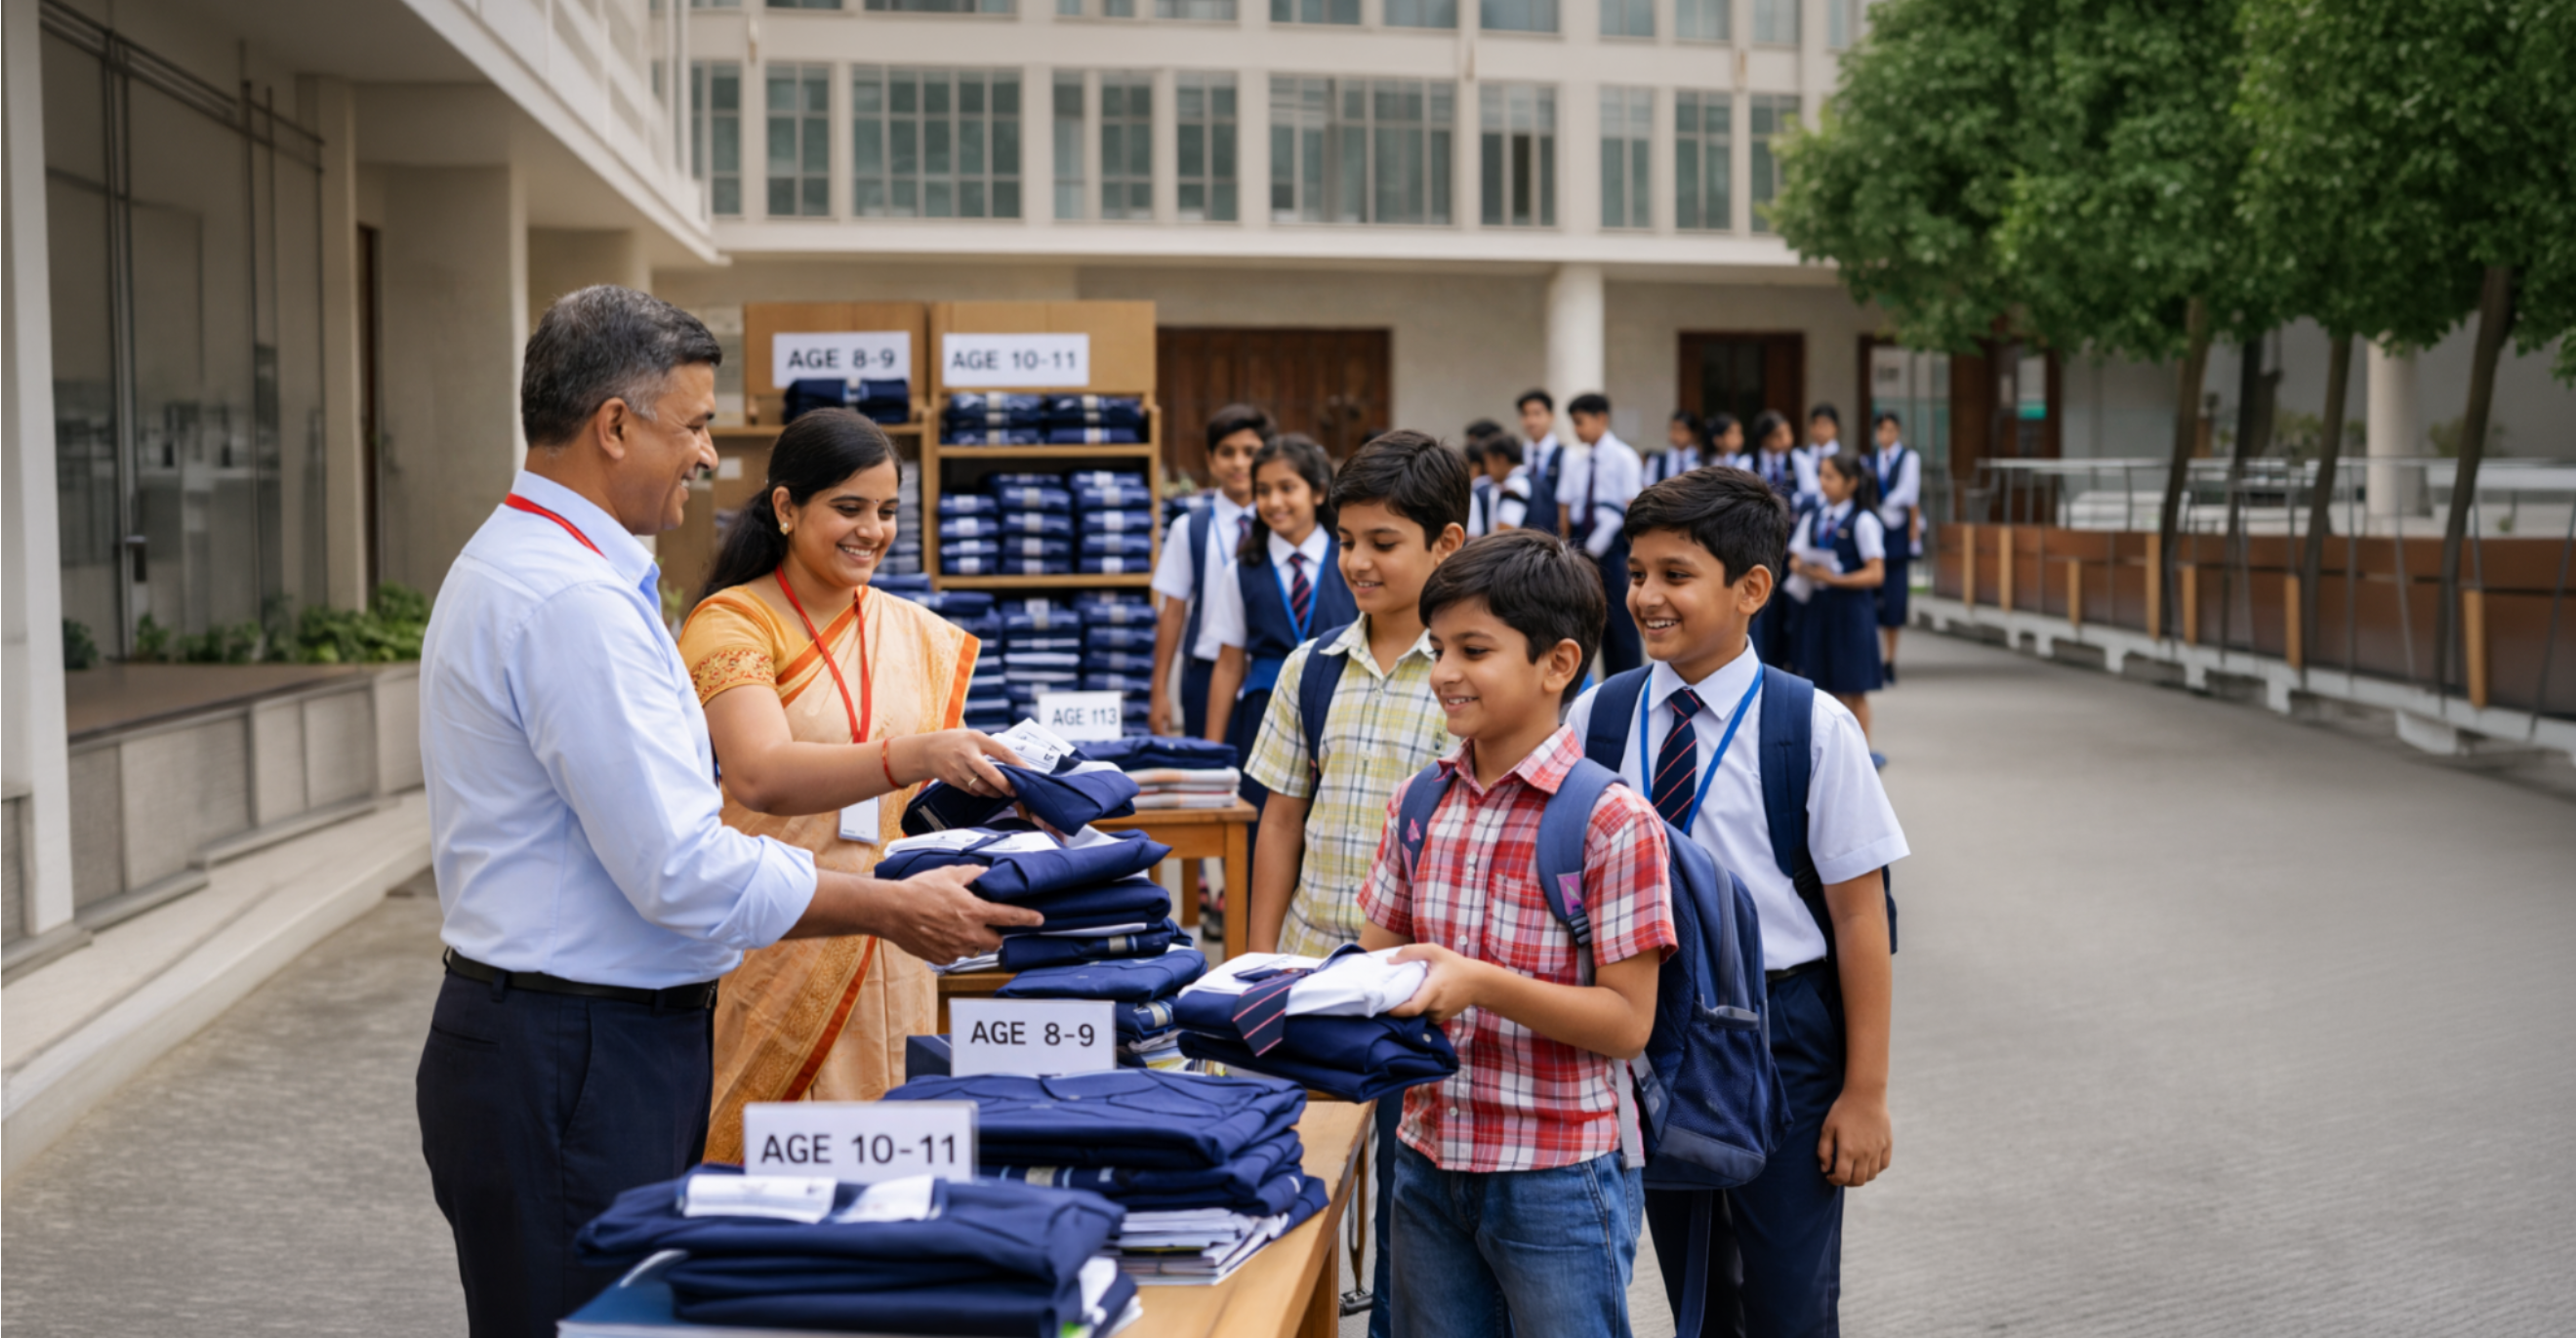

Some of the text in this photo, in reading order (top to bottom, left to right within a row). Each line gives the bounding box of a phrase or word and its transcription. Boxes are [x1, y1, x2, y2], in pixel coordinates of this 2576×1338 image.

[787, 347, 896, 370] AGE 8-9
[951, 348, 1077, 371] AGE 10-11
[1052, 707, 1085, 727] AGE
[970, 1020, 1095, 1047] AGE 8-9
[760, 1133, 956, 1165] AGE 10-11
